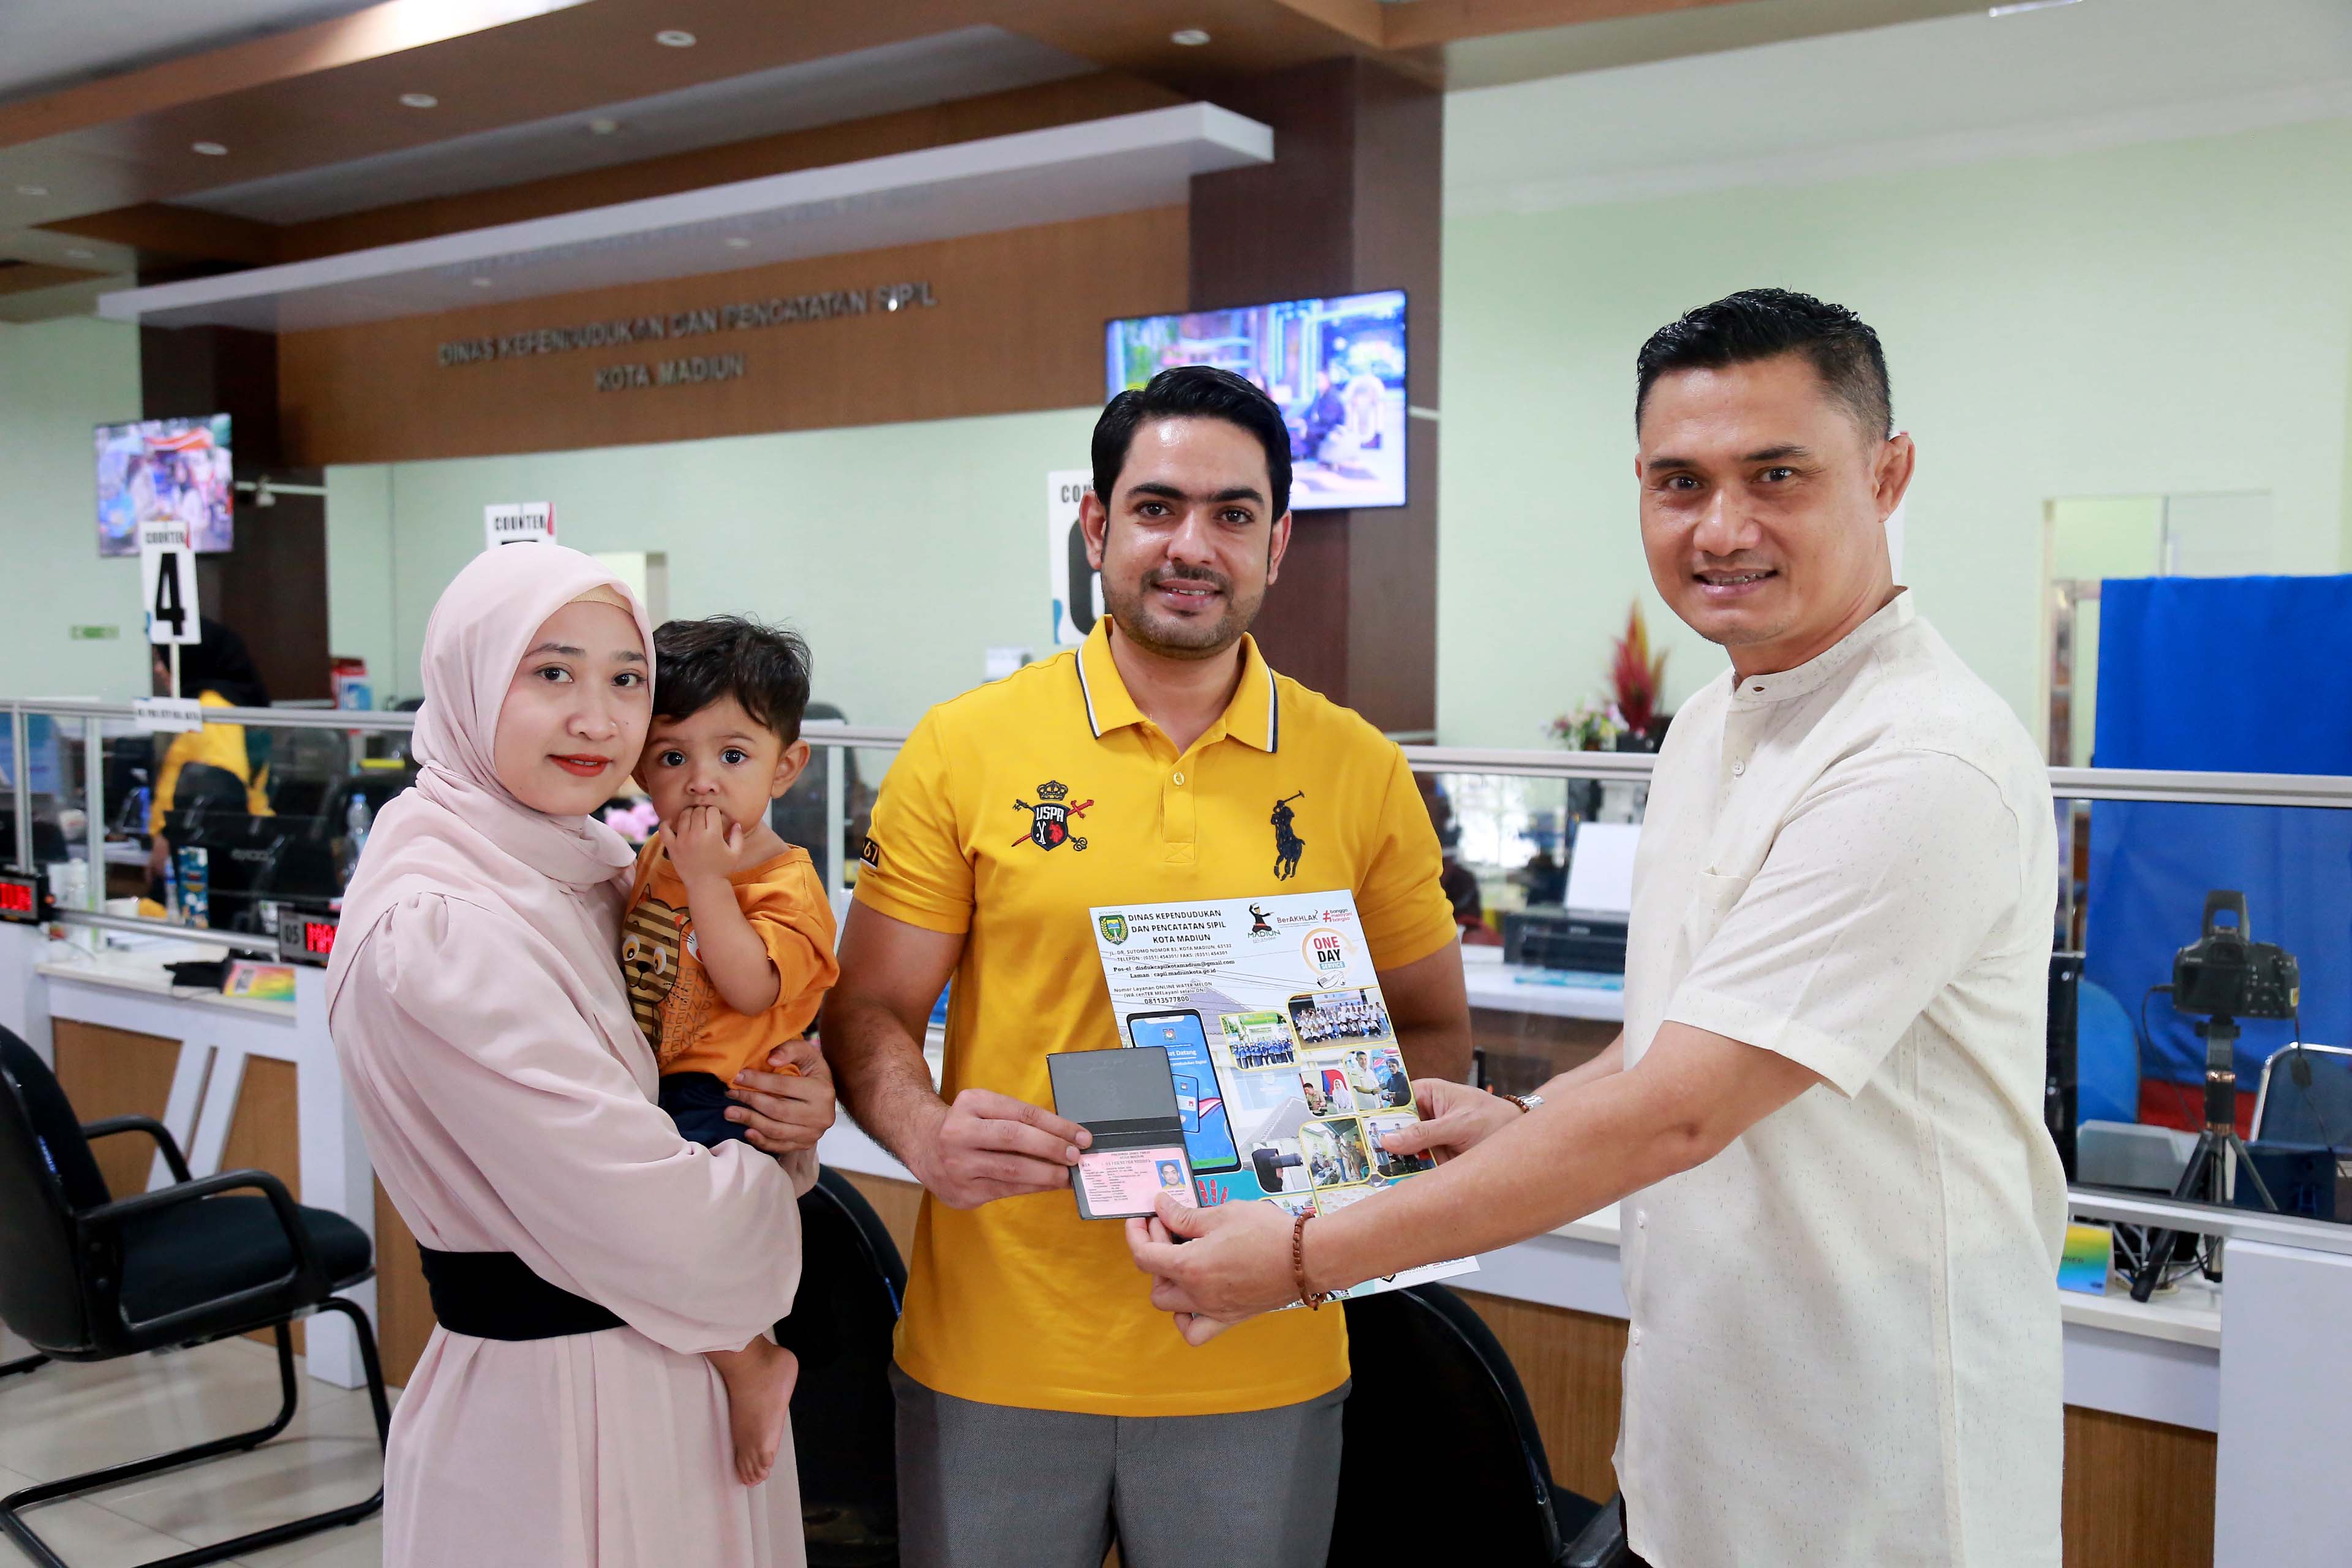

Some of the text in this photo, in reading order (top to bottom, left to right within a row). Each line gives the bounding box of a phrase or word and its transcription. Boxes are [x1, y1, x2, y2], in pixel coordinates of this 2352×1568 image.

[595, 353, 745, 392] KOTA MADIUN
[496, 515, 546, 530] COUNTER
[156, 553, 186, 636] 4
[1036, 807, 1065, 822] USPA
[1128, 910, 1222, 922] DINAS KEPENDUDUKAN
[1277, 913, 1318, 924] BerAKHLAK
[1152, 922, 1205, 932] PENCATATAN
[1248, 929, 1281, 938] MADIUN
[1313, 937, 1340, 949] ONE
[1317, 949, 1341, 963] DAY
[1135, 959, 1235, 971] disdukcapilkotamadiun@gmail.com
[1144, 996, 1189, 1005] 08113577800
